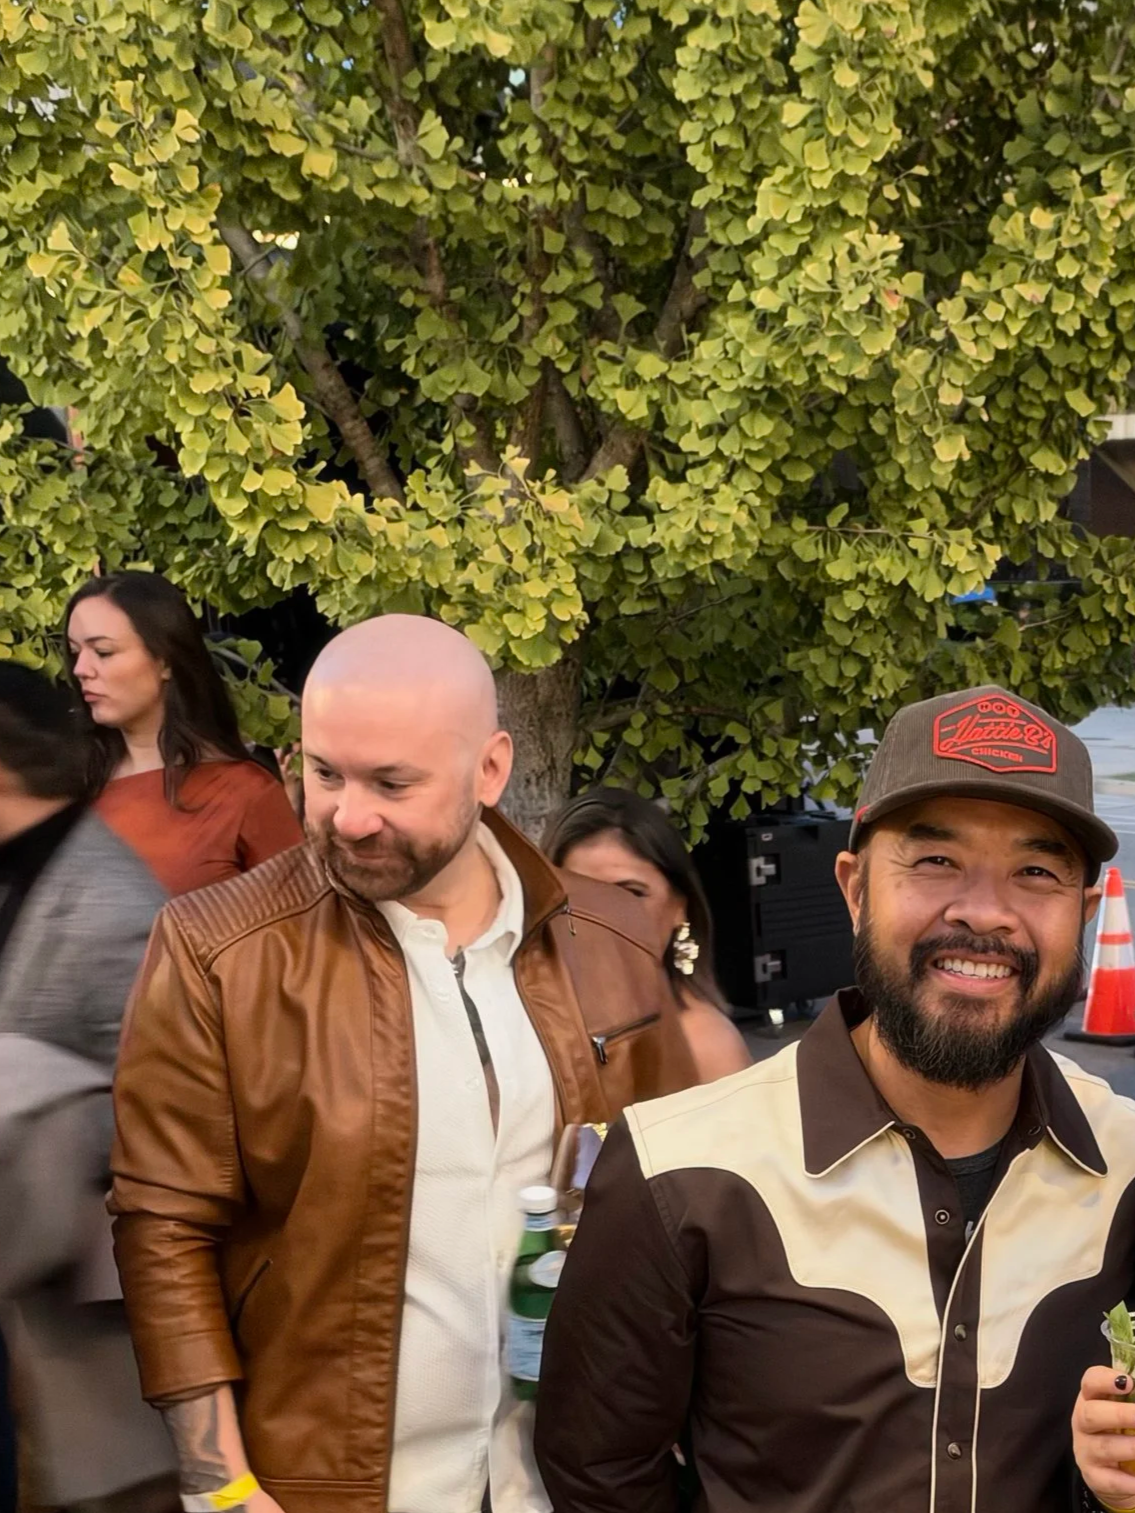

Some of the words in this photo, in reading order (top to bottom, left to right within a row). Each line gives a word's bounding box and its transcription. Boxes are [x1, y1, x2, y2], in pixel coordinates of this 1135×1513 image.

[977, 701, 1020, 718] HOT
[939, 714, 1023, 751] Hattie
[1023, 723, 1052, 749] B's
[971, 747, 1023, 762] CHICKEN
